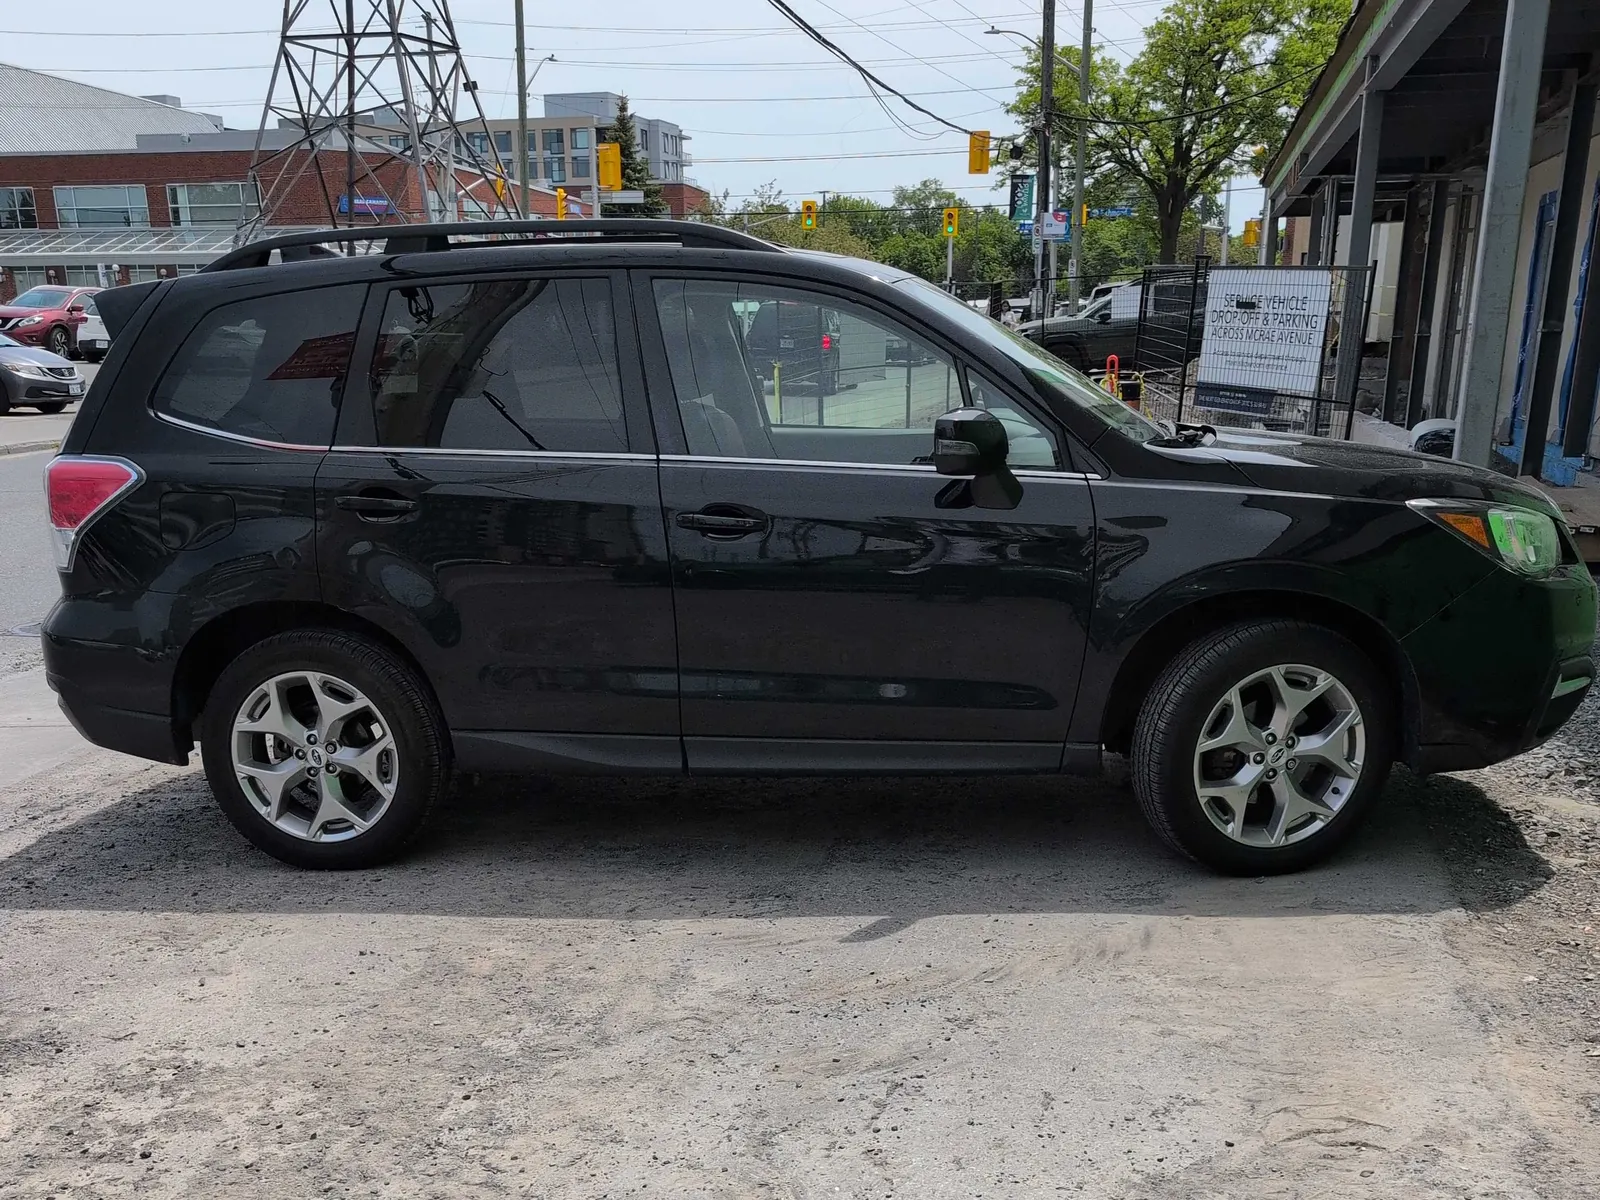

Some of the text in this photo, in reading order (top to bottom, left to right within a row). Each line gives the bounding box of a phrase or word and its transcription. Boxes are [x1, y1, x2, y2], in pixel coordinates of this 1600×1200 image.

[1266, 295, 1308, 311] VEHICLE
[1211, 310, 1319, 329] DROP-OFF & PARKING
[1211, 327, 1314, 345] ACROSS MCRAE AVENUE
